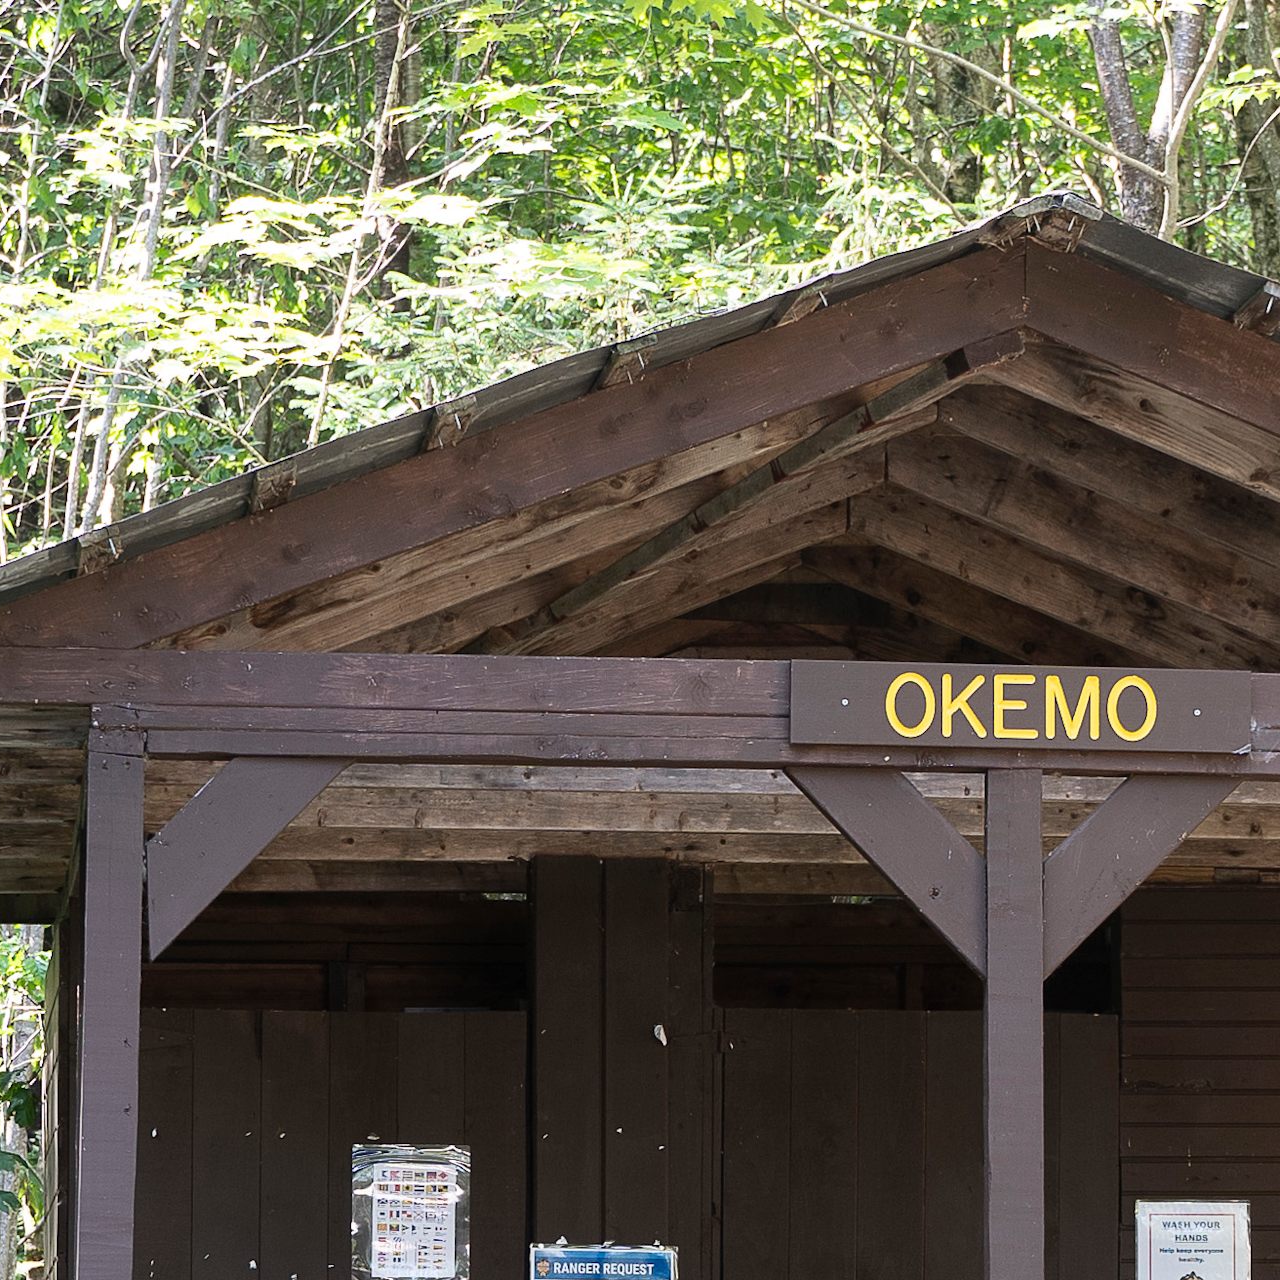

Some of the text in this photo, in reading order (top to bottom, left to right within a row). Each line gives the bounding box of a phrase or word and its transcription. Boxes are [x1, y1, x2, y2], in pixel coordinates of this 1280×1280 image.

[885, 672, 1157, 741] OKEMO
[1162, 1221, 1221, 1229] WASH YOUR
[1175, 1234, 1209, 1242] HANDS
[553, 1262, 655, 1276] RANGER REQUEST
